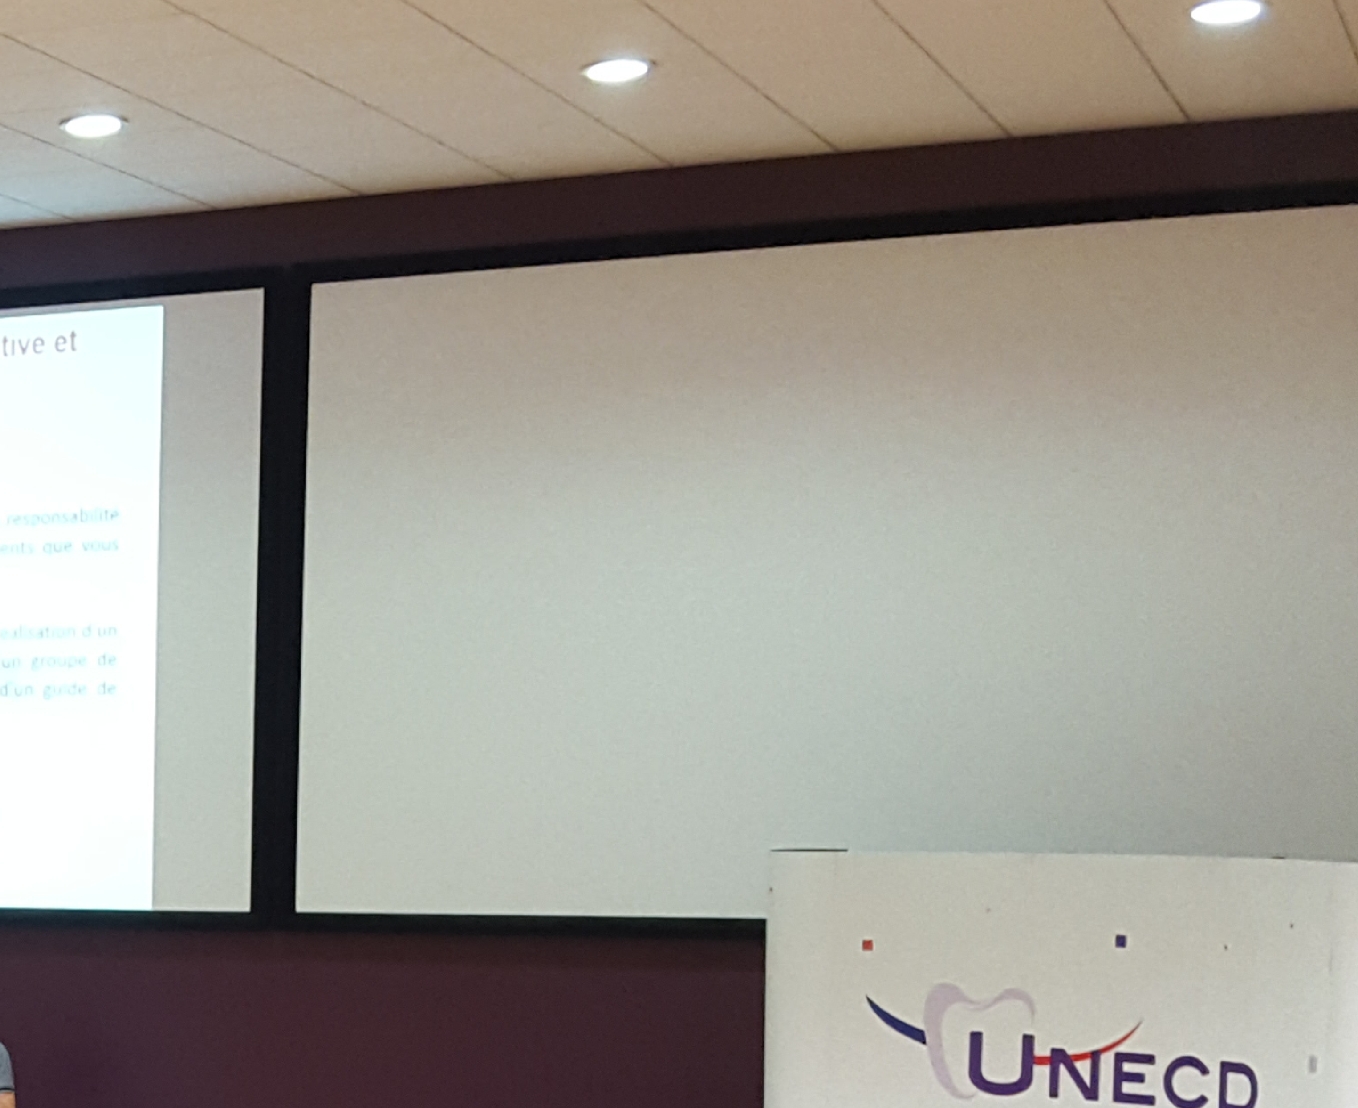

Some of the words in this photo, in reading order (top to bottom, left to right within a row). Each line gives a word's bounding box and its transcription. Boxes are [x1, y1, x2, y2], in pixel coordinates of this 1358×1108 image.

[54, 330, 78, 355] et
[42, 540, 73, 557] que
[81, 538, 119, 553] vous
[0, 657, 22, 670] un
[31, 655, 87, 672] groupe
[96, 652, 117, 667] de
[96, 680, 117, 696] de
